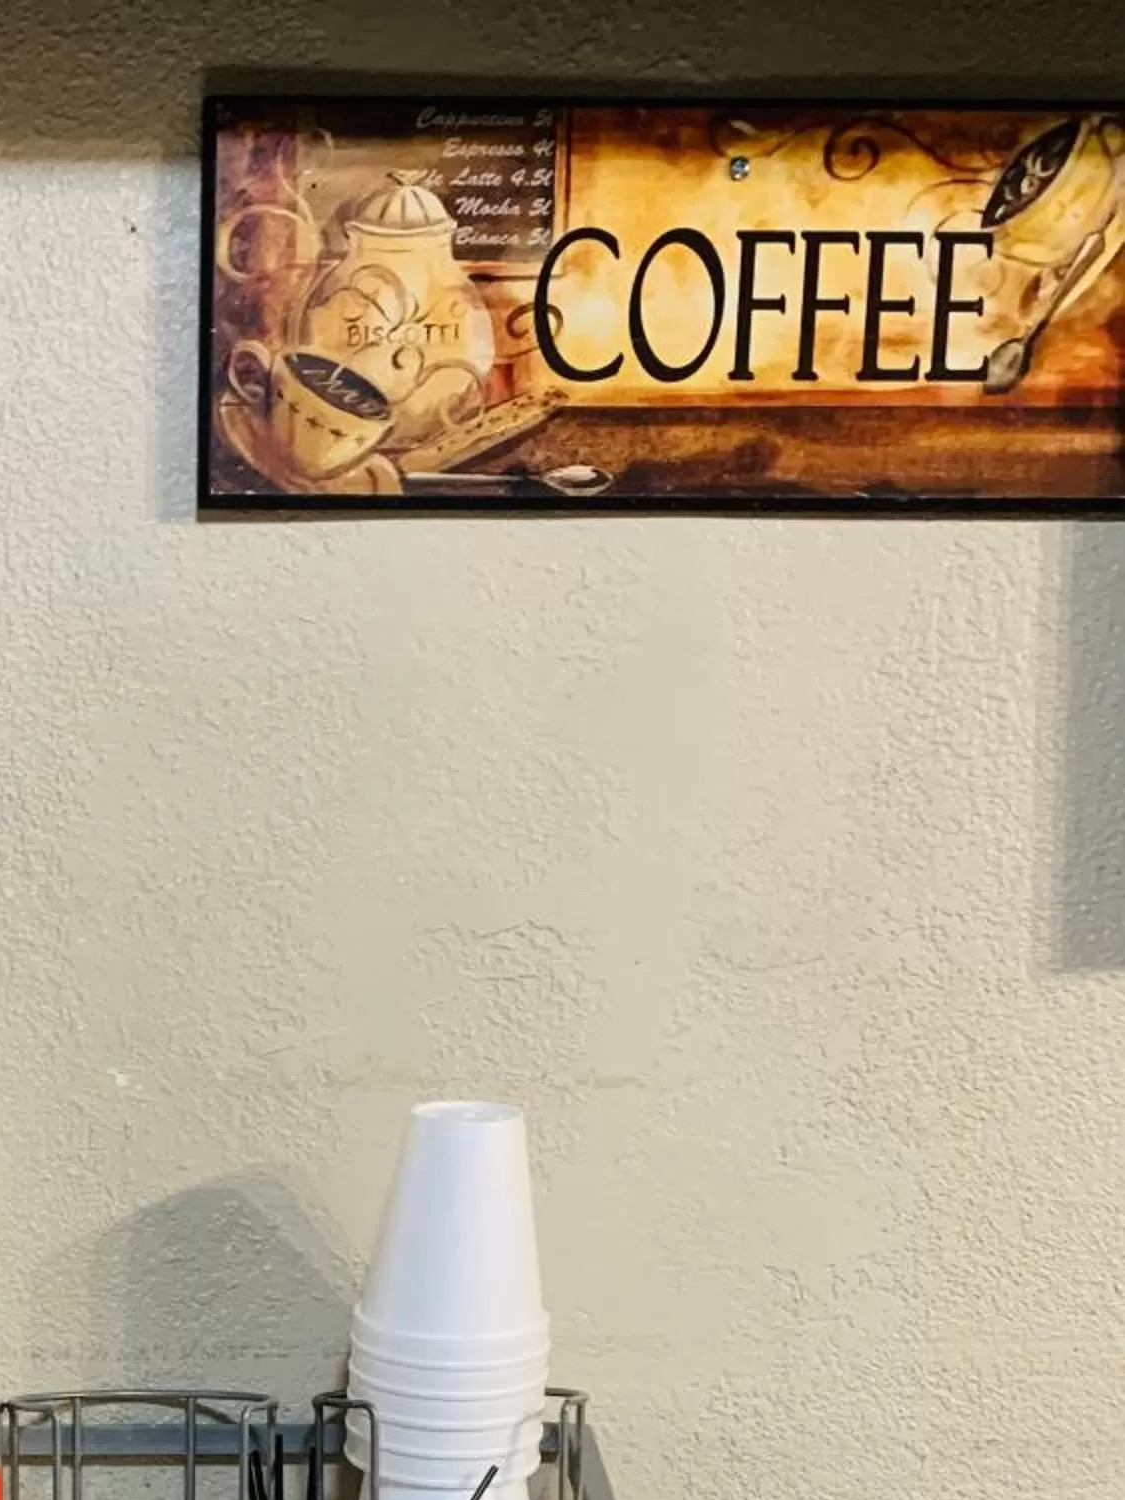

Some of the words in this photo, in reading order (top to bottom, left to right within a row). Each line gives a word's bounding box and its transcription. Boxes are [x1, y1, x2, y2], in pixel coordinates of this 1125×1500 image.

[442, 137, 525, 158] Espresso
[450, 167, 503, 187] Latte
[454, 196, 522, 216] Mocha
[534, 227, 993, 382] COFFEE
[346, 322, 460, 347] BISCOTTI
